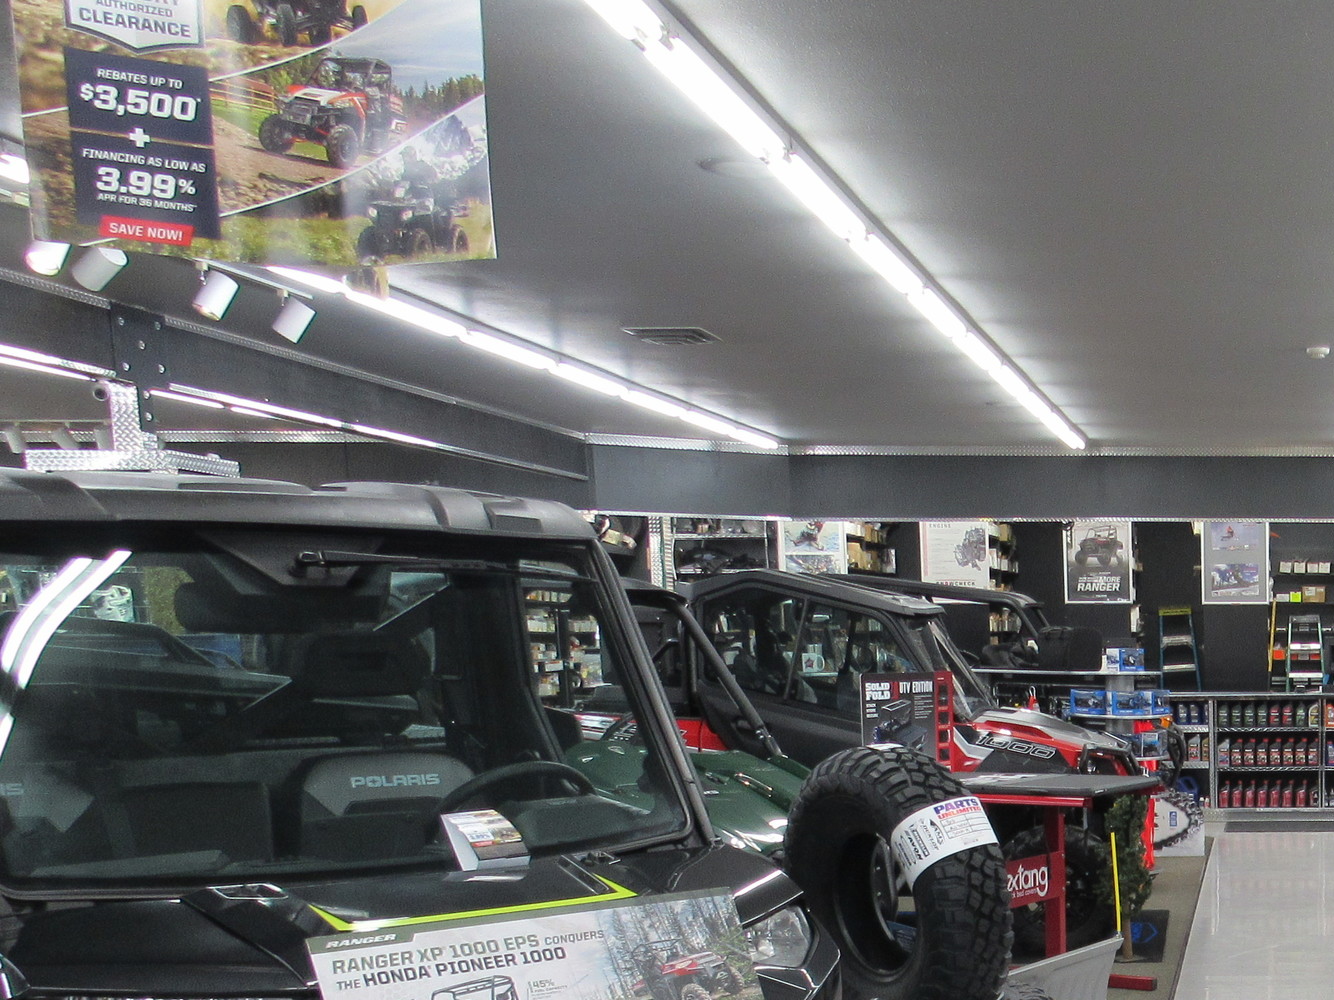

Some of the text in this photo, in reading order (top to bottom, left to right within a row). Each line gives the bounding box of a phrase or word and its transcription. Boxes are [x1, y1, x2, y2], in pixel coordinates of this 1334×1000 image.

[96, 0, 173, 17] AUTHORIZED
[79, 7, 191, 38] CLEARANCE
[97, 68, 183, 90] REBATES UP TO
[82, 148, 206, 173] FINANCING AS LOW AS
[96, 166, 197, 199] 3.99%
[97, 193, 118, 202] APR
[118, 195, 139, 206] FOR
[139, 197, 153, 207] 36
[109, 222, 183, 241] SAVE NOW!
[1077, 583, 1121, 592] RANGER
[865, 681, 934, 693] SOLID UTV EDITION
[866, 691, 891, 700] FOLD
[976, 734, 1056, 759] 1000
[351, 773, 440, 788] POLARIS
[933, 798, 979, 815] PARTS
[908, 836, 923, 860] AVON
[326, 933, 397, 948] RANGER
[332, 930, 605, 974] RANGER XP 1000 EPS CONQUERS
[336, 947, 567, 991] THE HONDA PIONEER 1000
[532, 979, 555, 989] 45%
